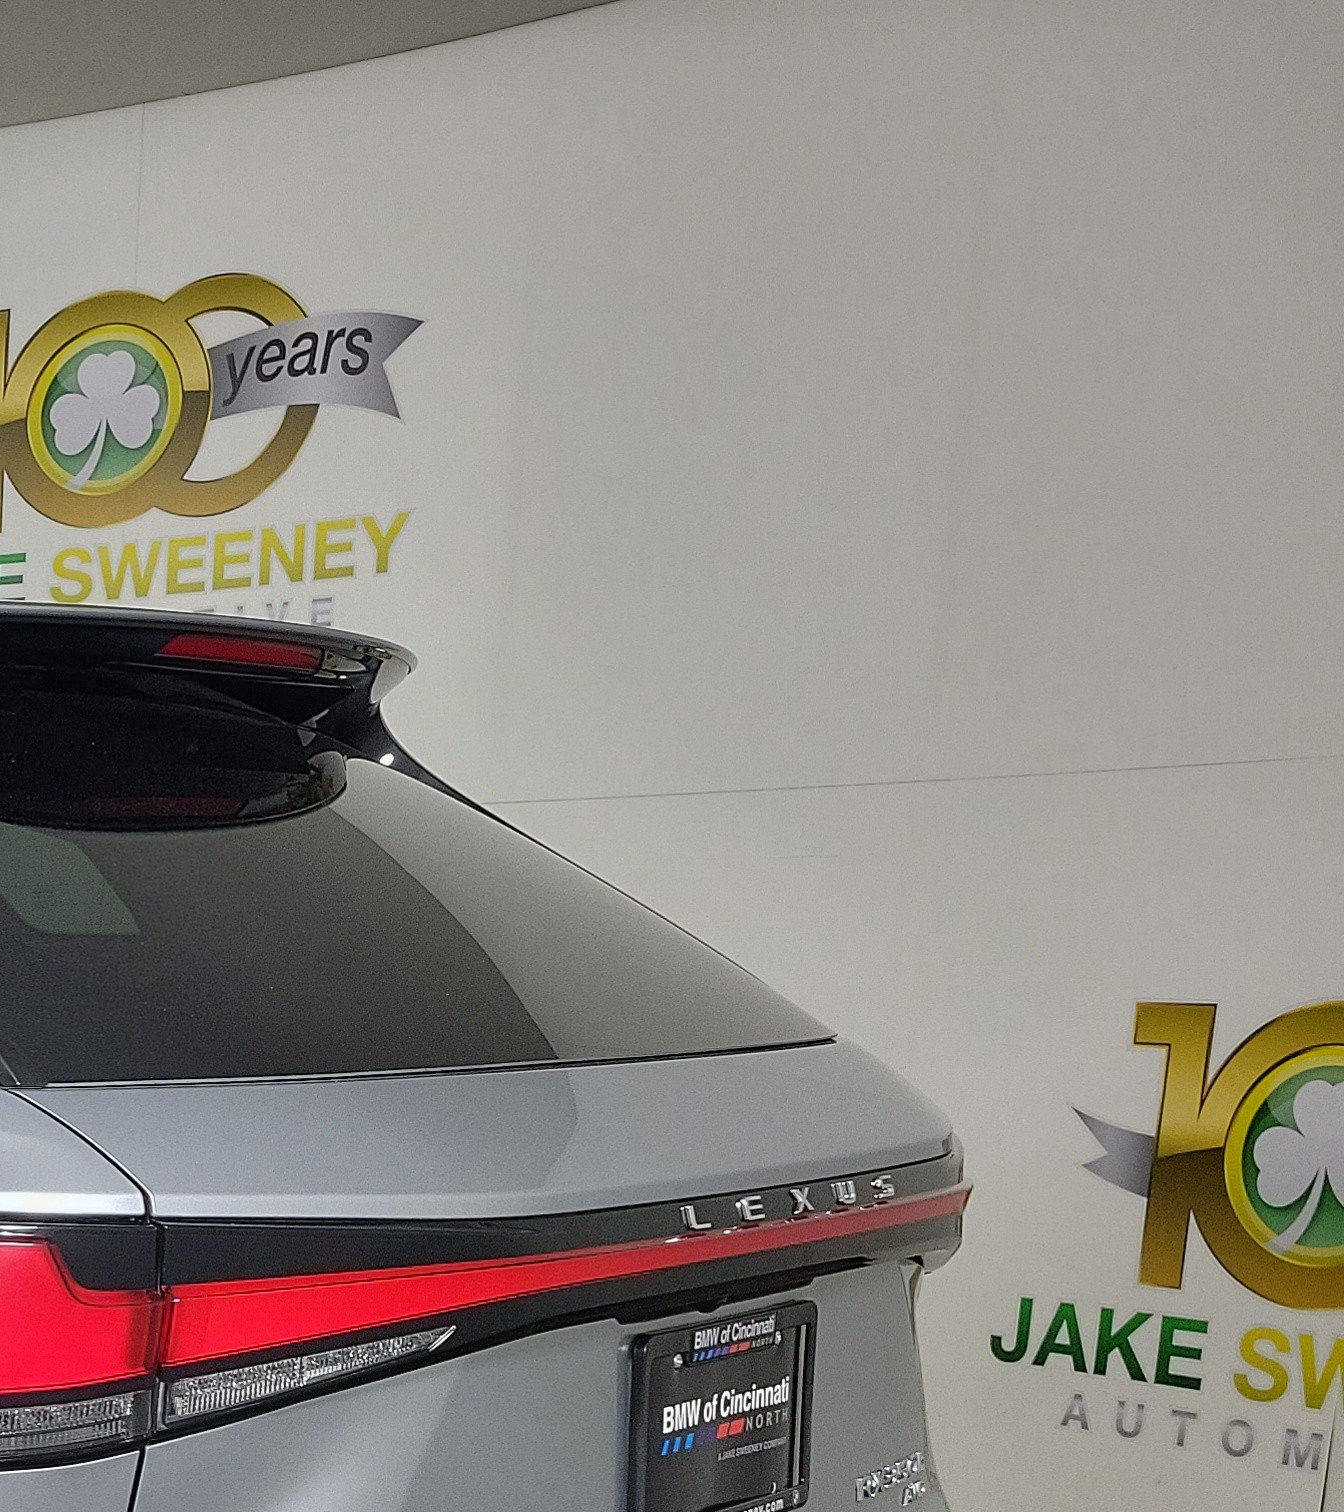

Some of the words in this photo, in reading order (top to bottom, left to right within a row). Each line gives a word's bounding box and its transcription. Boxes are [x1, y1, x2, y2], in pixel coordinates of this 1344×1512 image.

[222, 325, 373, 407] years
[49, 510, 412, 604] SWEENEY
[679, 1174, 895, 1230] LEXUS
[694, 1327, 721, 1350] BMW
[720, 1324, 731, 1344] of
[731, 1314, 776, 1341] Cincinnati
[990, 1297, 1209, 1391] JAKE
[662, 1398, 702, 1434] BMW
[703, 1393, 719, 1423] of
[720, 1375, 790, 1418] Cincinnati
[745, 1407, 790, 1432] NORTH
